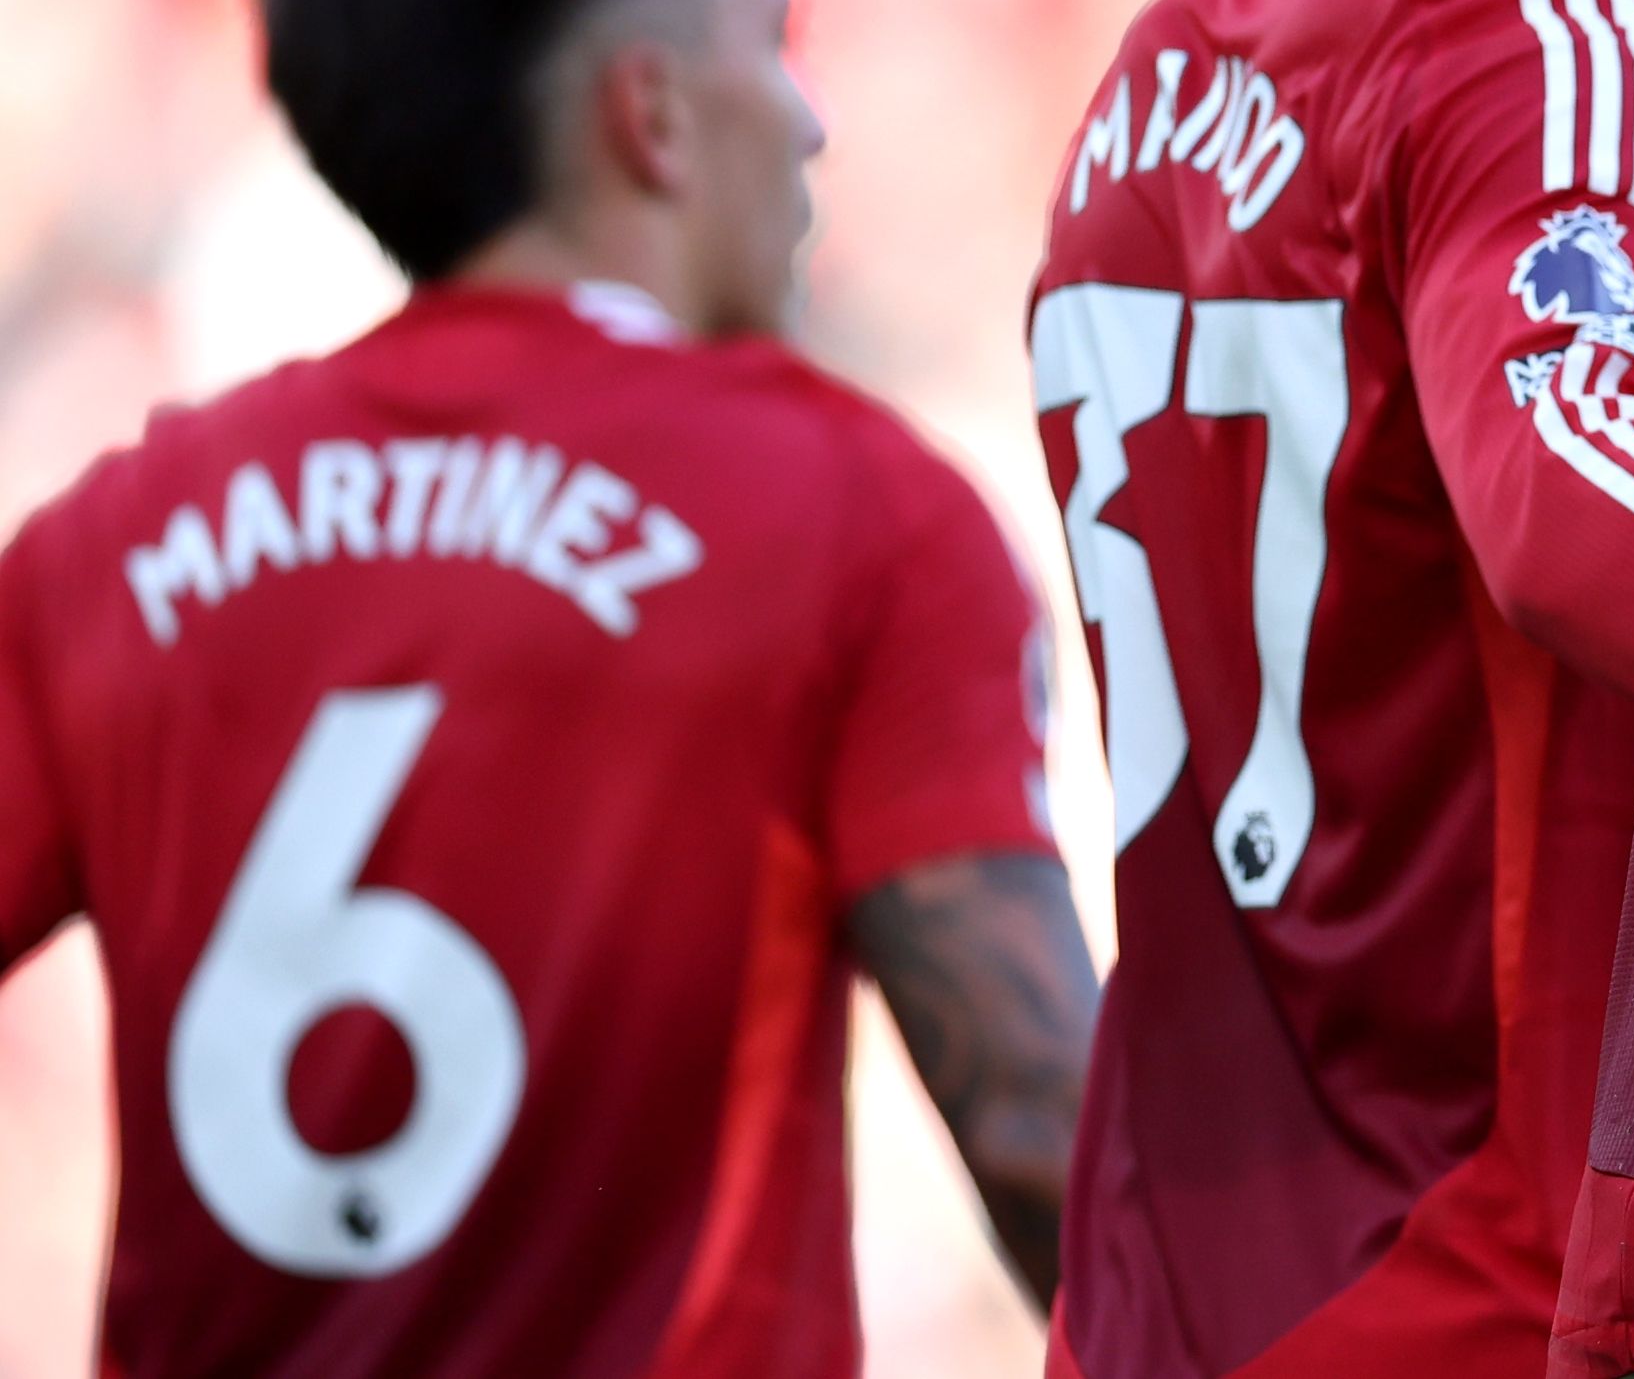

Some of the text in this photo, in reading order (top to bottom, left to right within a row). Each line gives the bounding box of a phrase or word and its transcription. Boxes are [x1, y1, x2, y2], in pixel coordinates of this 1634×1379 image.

[123, 433, 705, 651] MARTINEZ
[1032, 280, 1351, 909] 37
[167, 683, 528, 1279] 6
